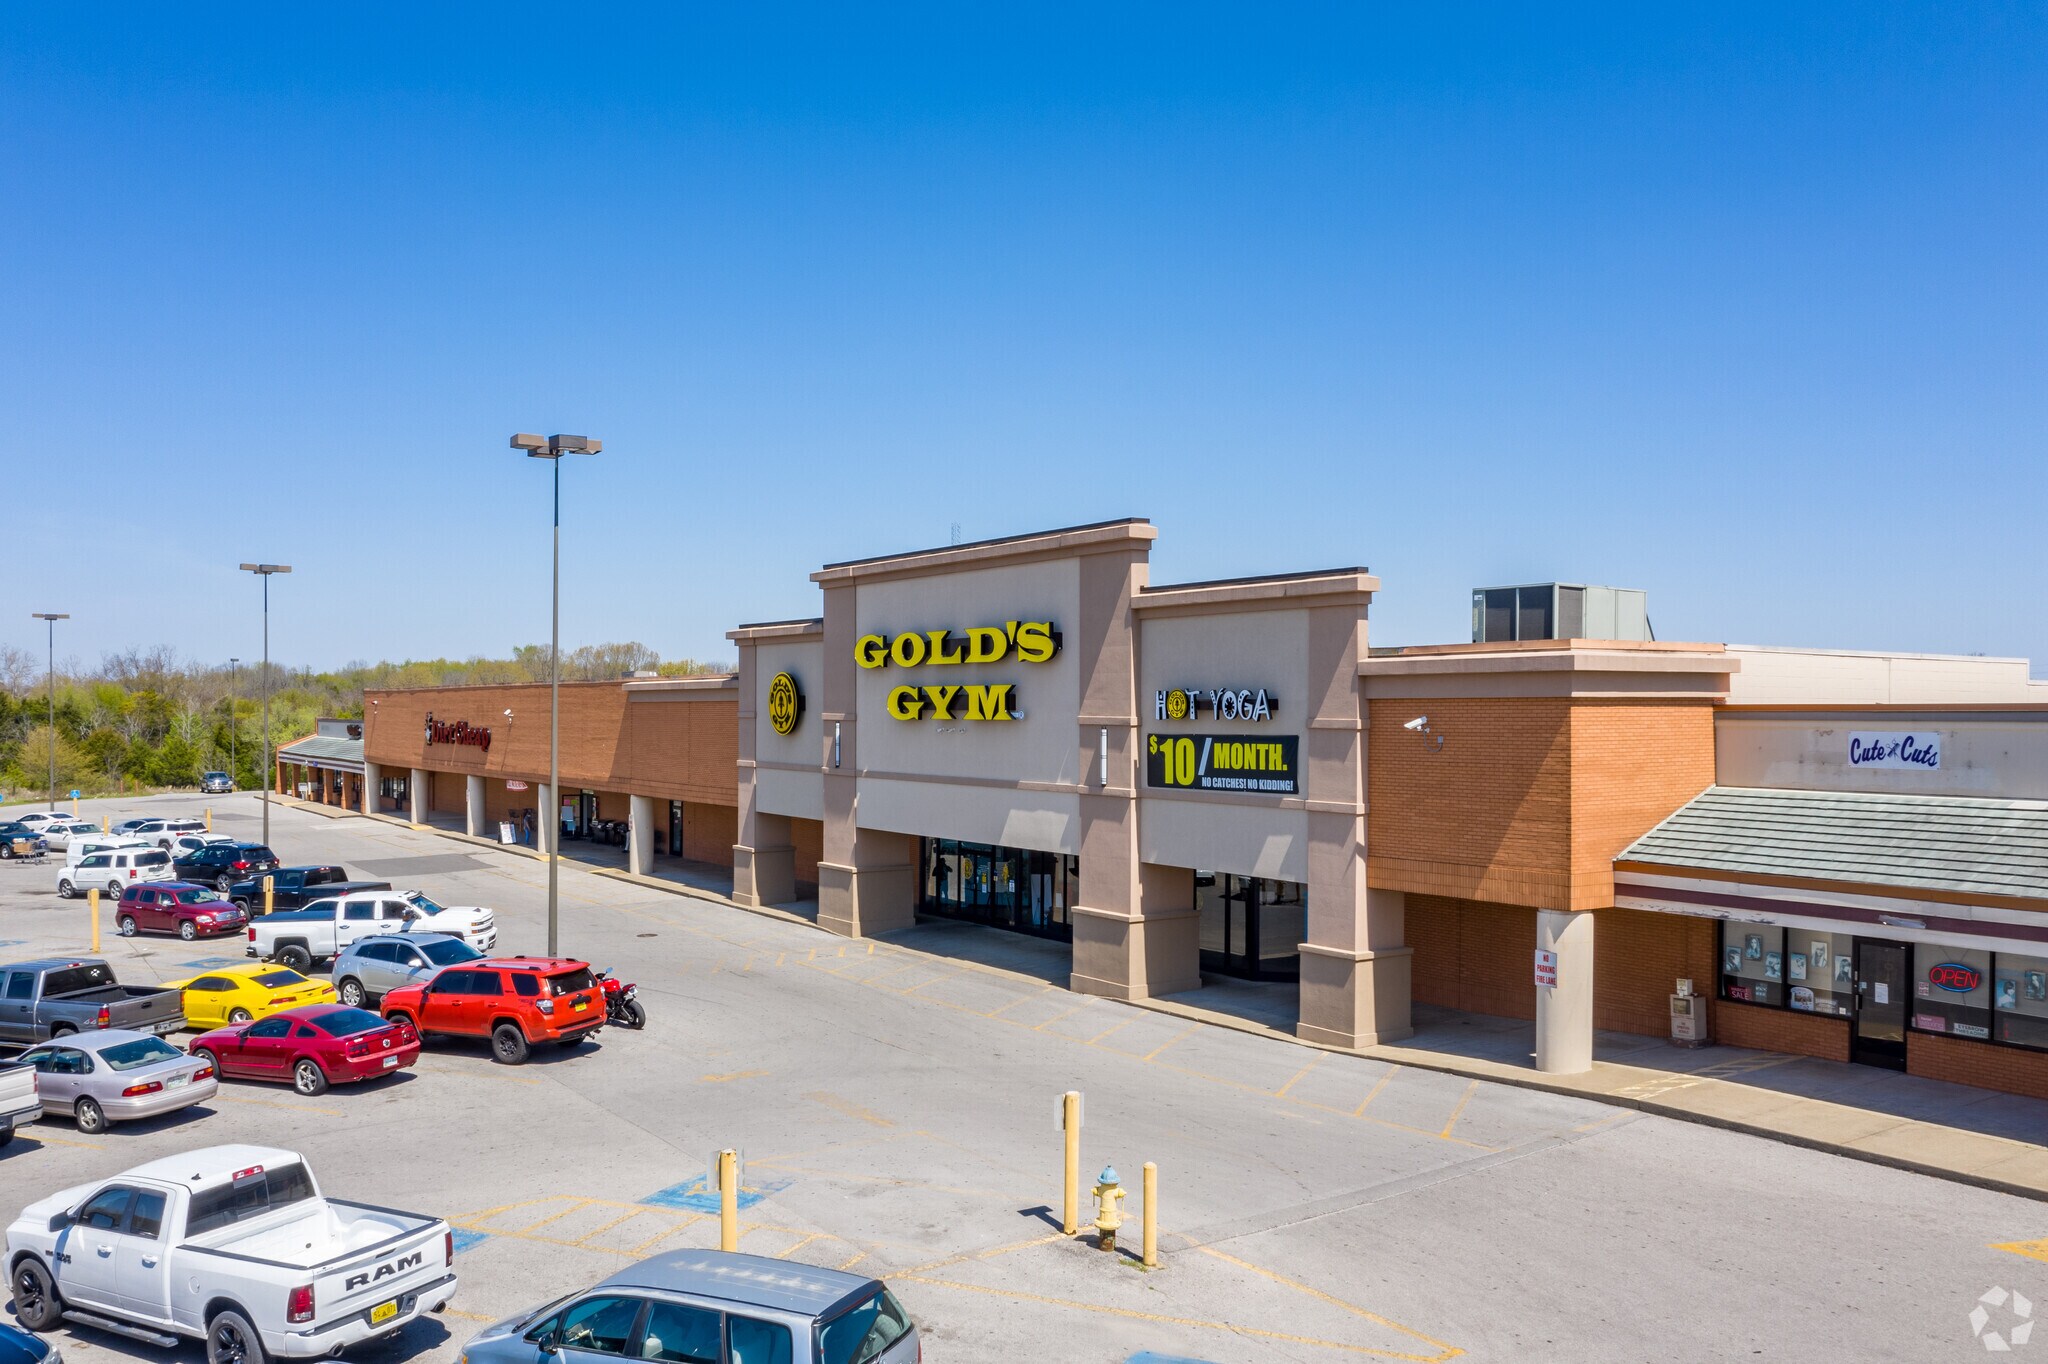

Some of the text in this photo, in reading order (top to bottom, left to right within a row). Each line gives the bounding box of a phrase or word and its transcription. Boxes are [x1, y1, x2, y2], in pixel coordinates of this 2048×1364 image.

[854, 620, 1054, 669] GOLD'S
[887, 684, 1014, 721] GYM
[1155, 688, 1272, 721] HOT YOGA
[456, 720, 491, 752] Cheap
[1850, 735, 1938, 767] Cute Cuts
[1202, 776, 1294, 791] NO CATCHES! NO KIDDING!
[1536, 975, 1545, 983] FIRE
[1929, 967, 1980, 988] OPEN
[1731, 991, 1749, 1001] SALE
[345, 1251, 423, 1292] RAM
